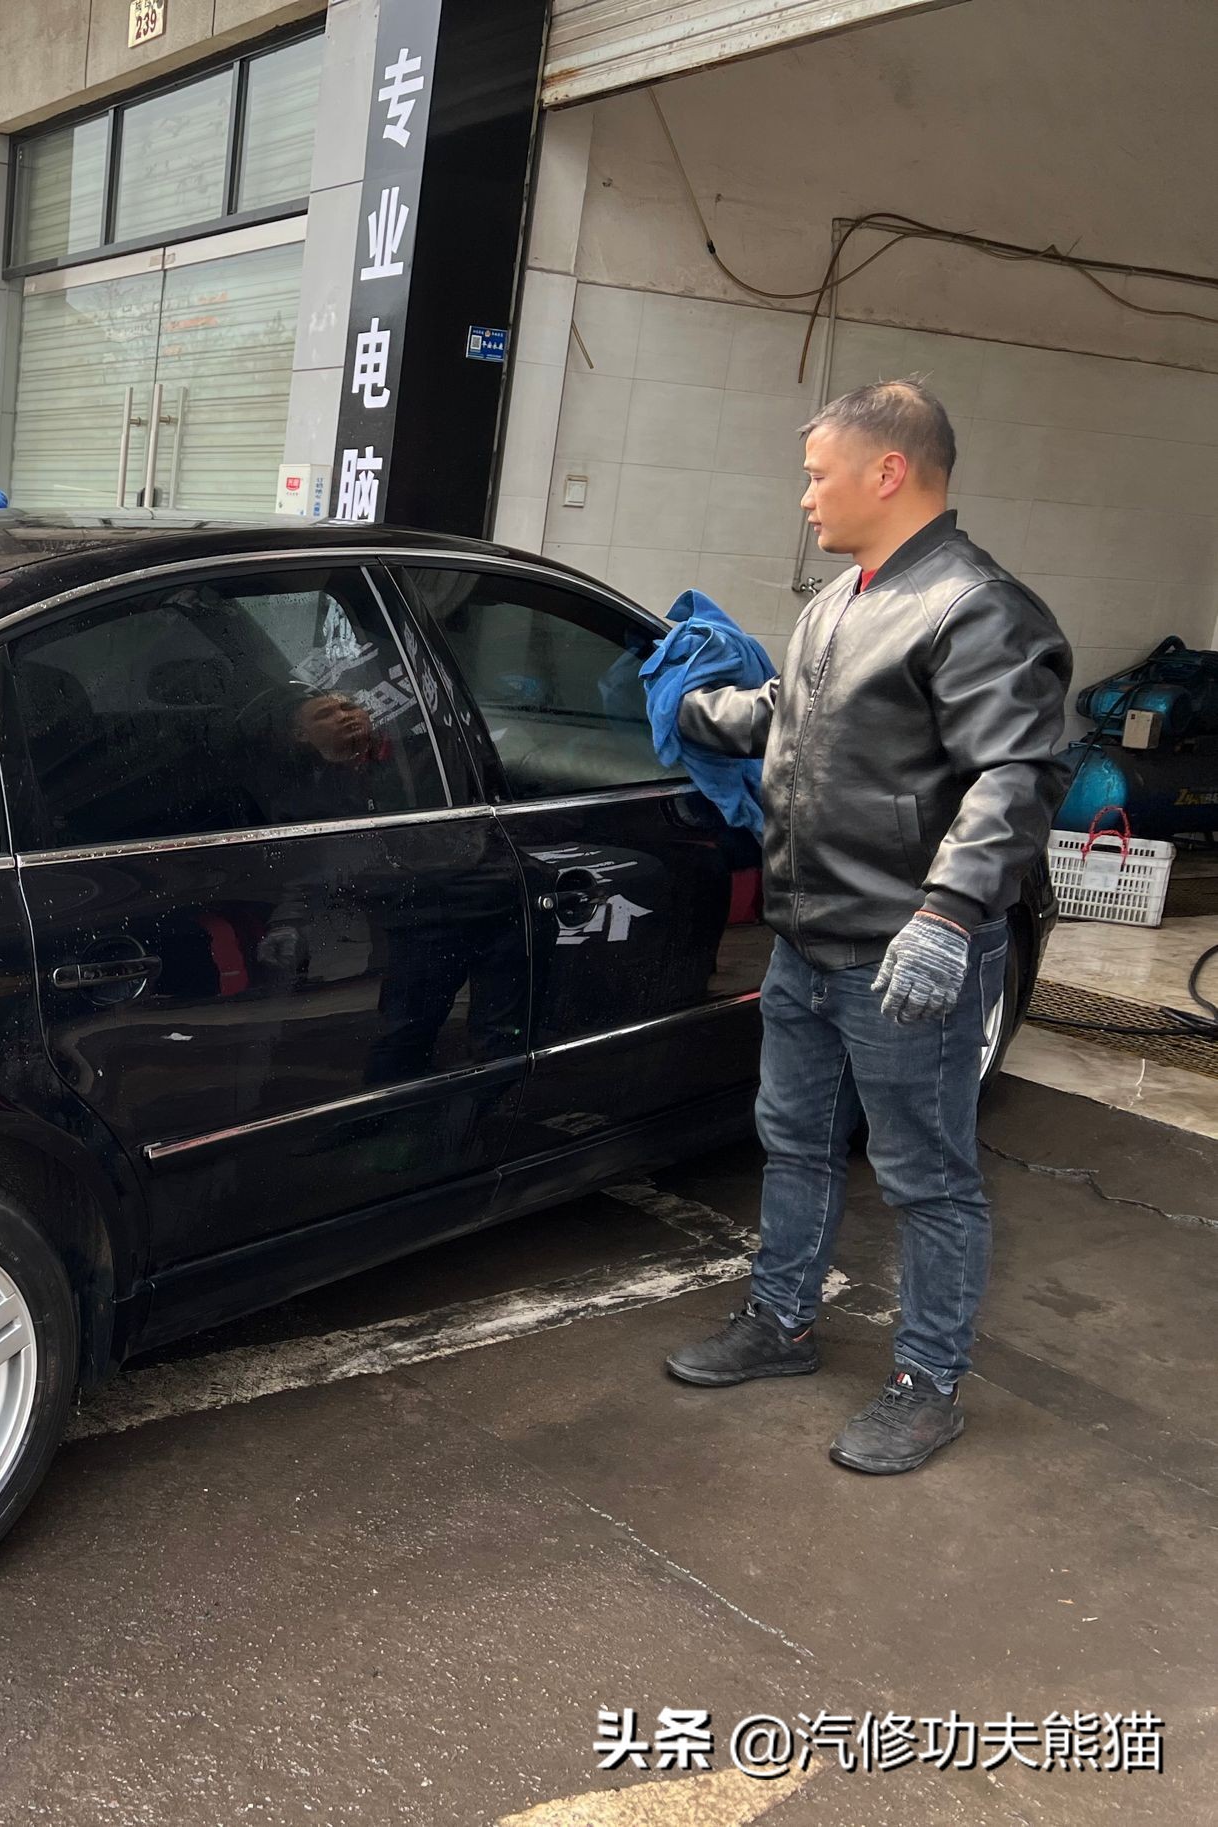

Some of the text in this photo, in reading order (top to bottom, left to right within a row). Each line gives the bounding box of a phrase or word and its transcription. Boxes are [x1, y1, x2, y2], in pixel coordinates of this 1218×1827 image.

[135, 9, 157, 40] 239
[336, 47, 425, 523] 专业电脑
